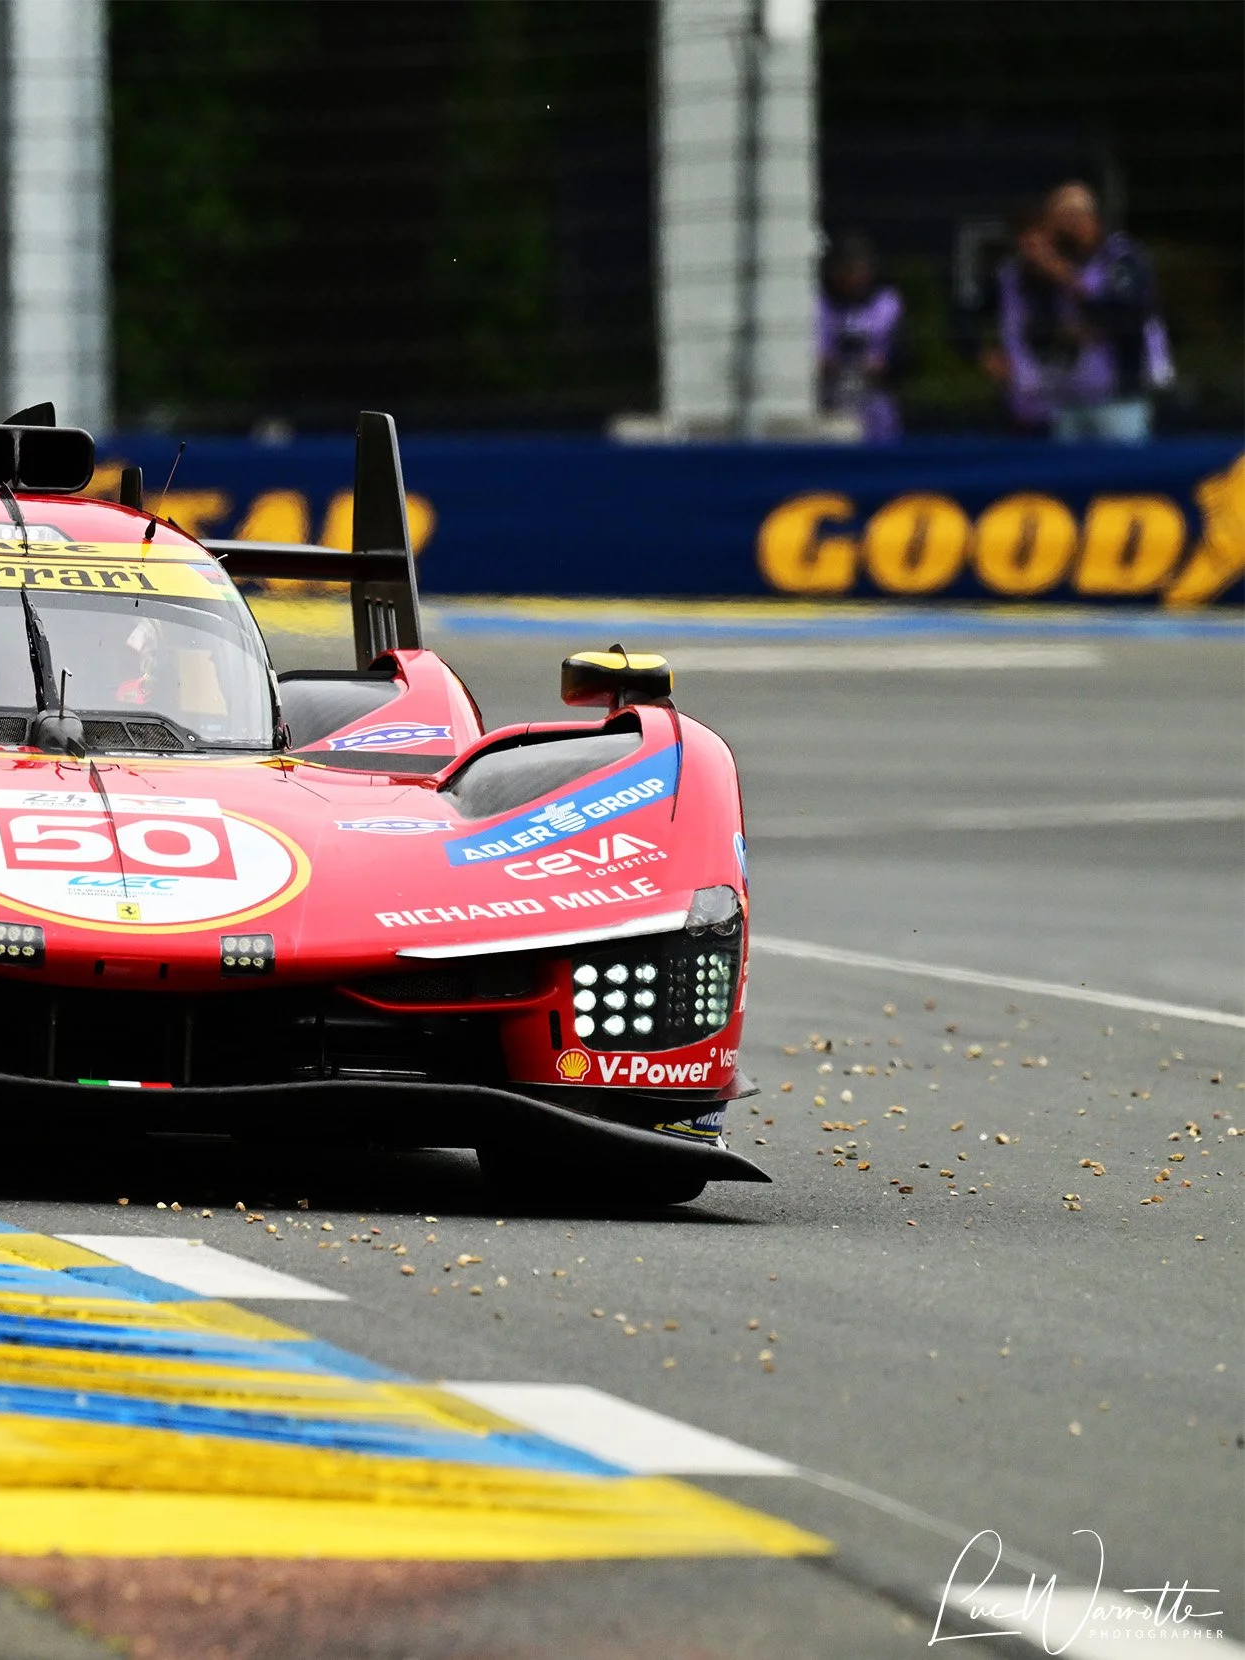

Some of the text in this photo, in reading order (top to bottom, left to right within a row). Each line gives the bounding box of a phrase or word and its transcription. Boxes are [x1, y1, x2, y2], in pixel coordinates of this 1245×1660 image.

[343, 729, 438, 747] FAGE
[461, 777, 665, 863] ADLER GROUP
[8, 815, 221, 868] 50
[585, 850, 668, 879] LOGISTICS
[67, 875, 181, 890] WEC
[375, 877, 662, 929] RICHARD MILLE
[597, 1054, 713, 1084] V-Power
